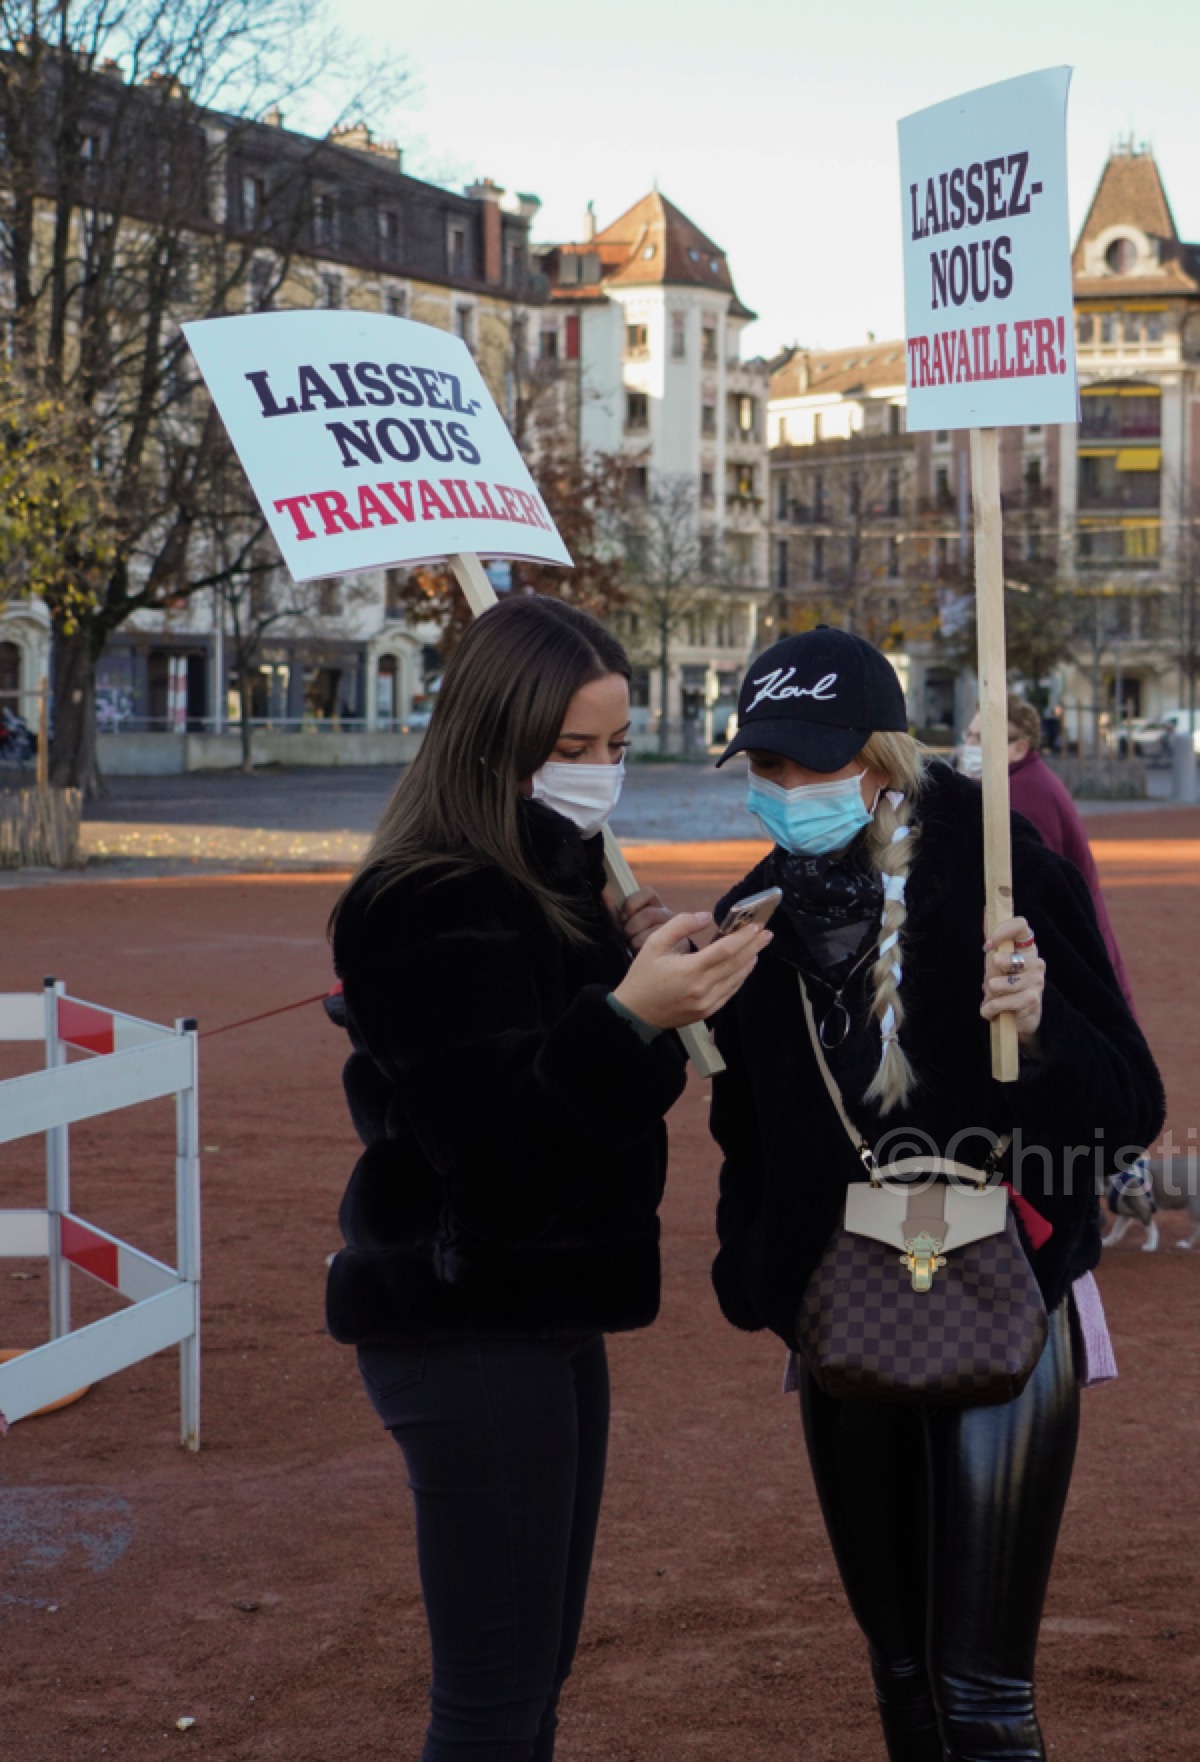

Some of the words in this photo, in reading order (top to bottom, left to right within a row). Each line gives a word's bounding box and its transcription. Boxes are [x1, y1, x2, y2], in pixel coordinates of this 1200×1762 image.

[909, 150, 1043, 241] LAISSEZ-
[929, 235, 1014, 310] NOUS
[907, 315, 1067, 388] TRAVAILLER!
[244, 361, 482, 418] LAISSEZ-
[325, 417, 481, 468] NOUS
[273, 479, 553, 541] TRAVAILLER!
[745, 665, 838, 713] Karl
